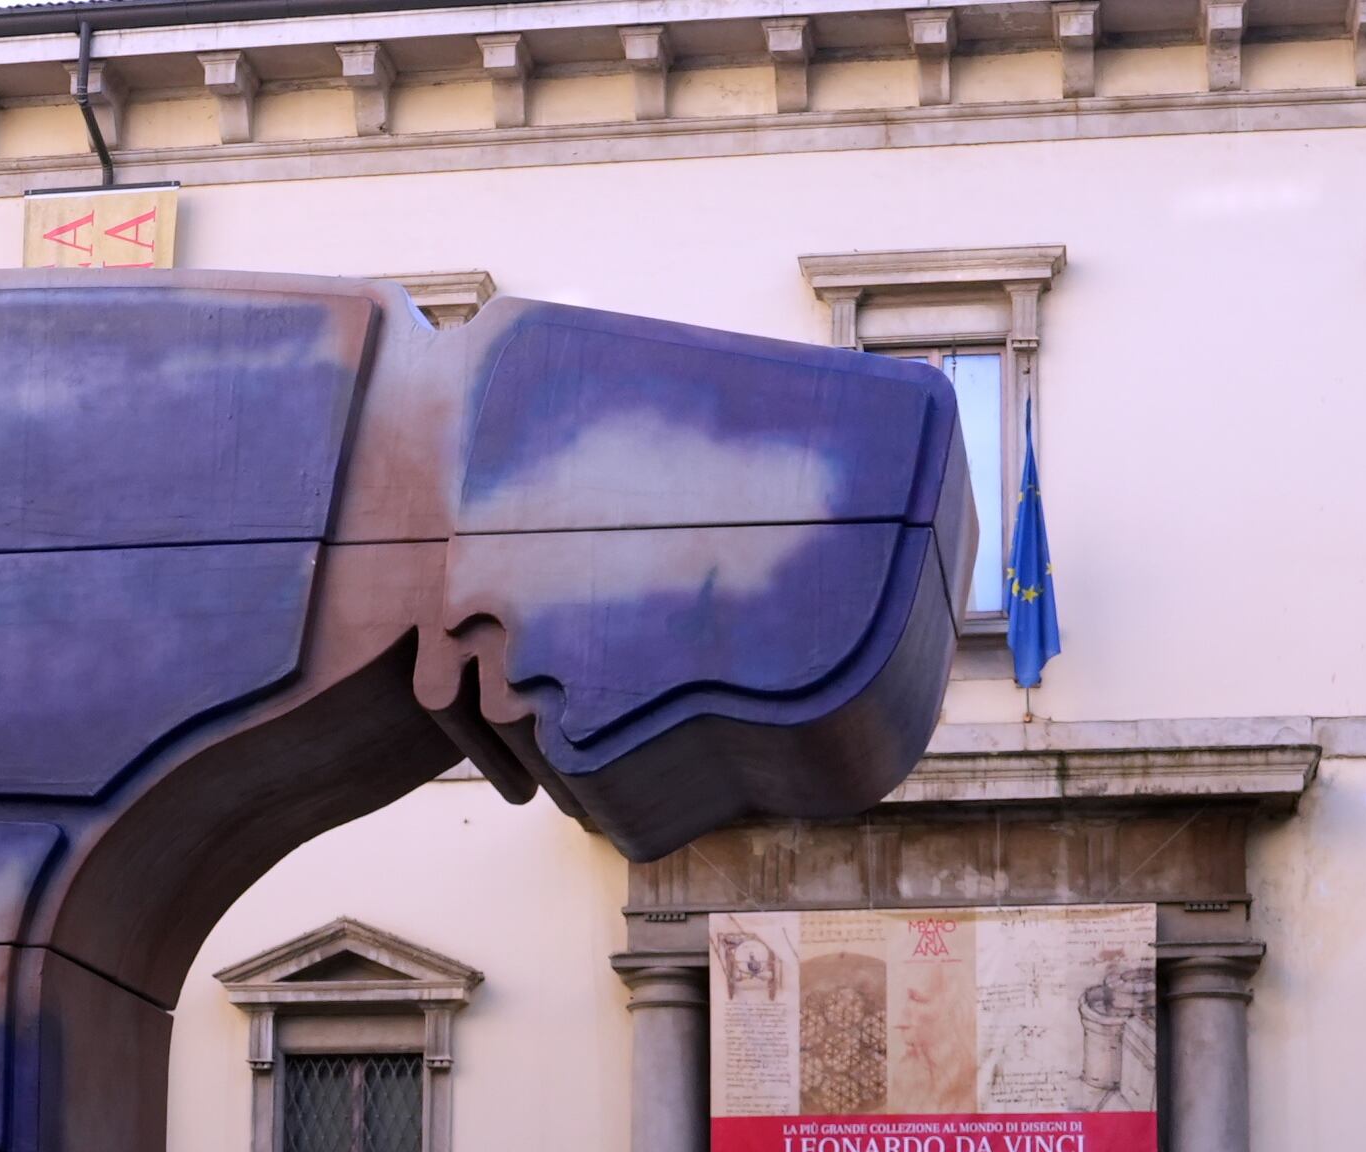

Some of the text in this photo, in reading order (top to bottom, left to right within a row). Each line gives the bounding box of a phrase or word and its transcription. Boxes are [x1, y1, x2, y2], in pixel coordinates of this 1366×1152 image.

[783, 1121, 1082, 1135] LA PIÙ GRANDE COLLEZIONE AL MONDO DI DISEGNI DI
